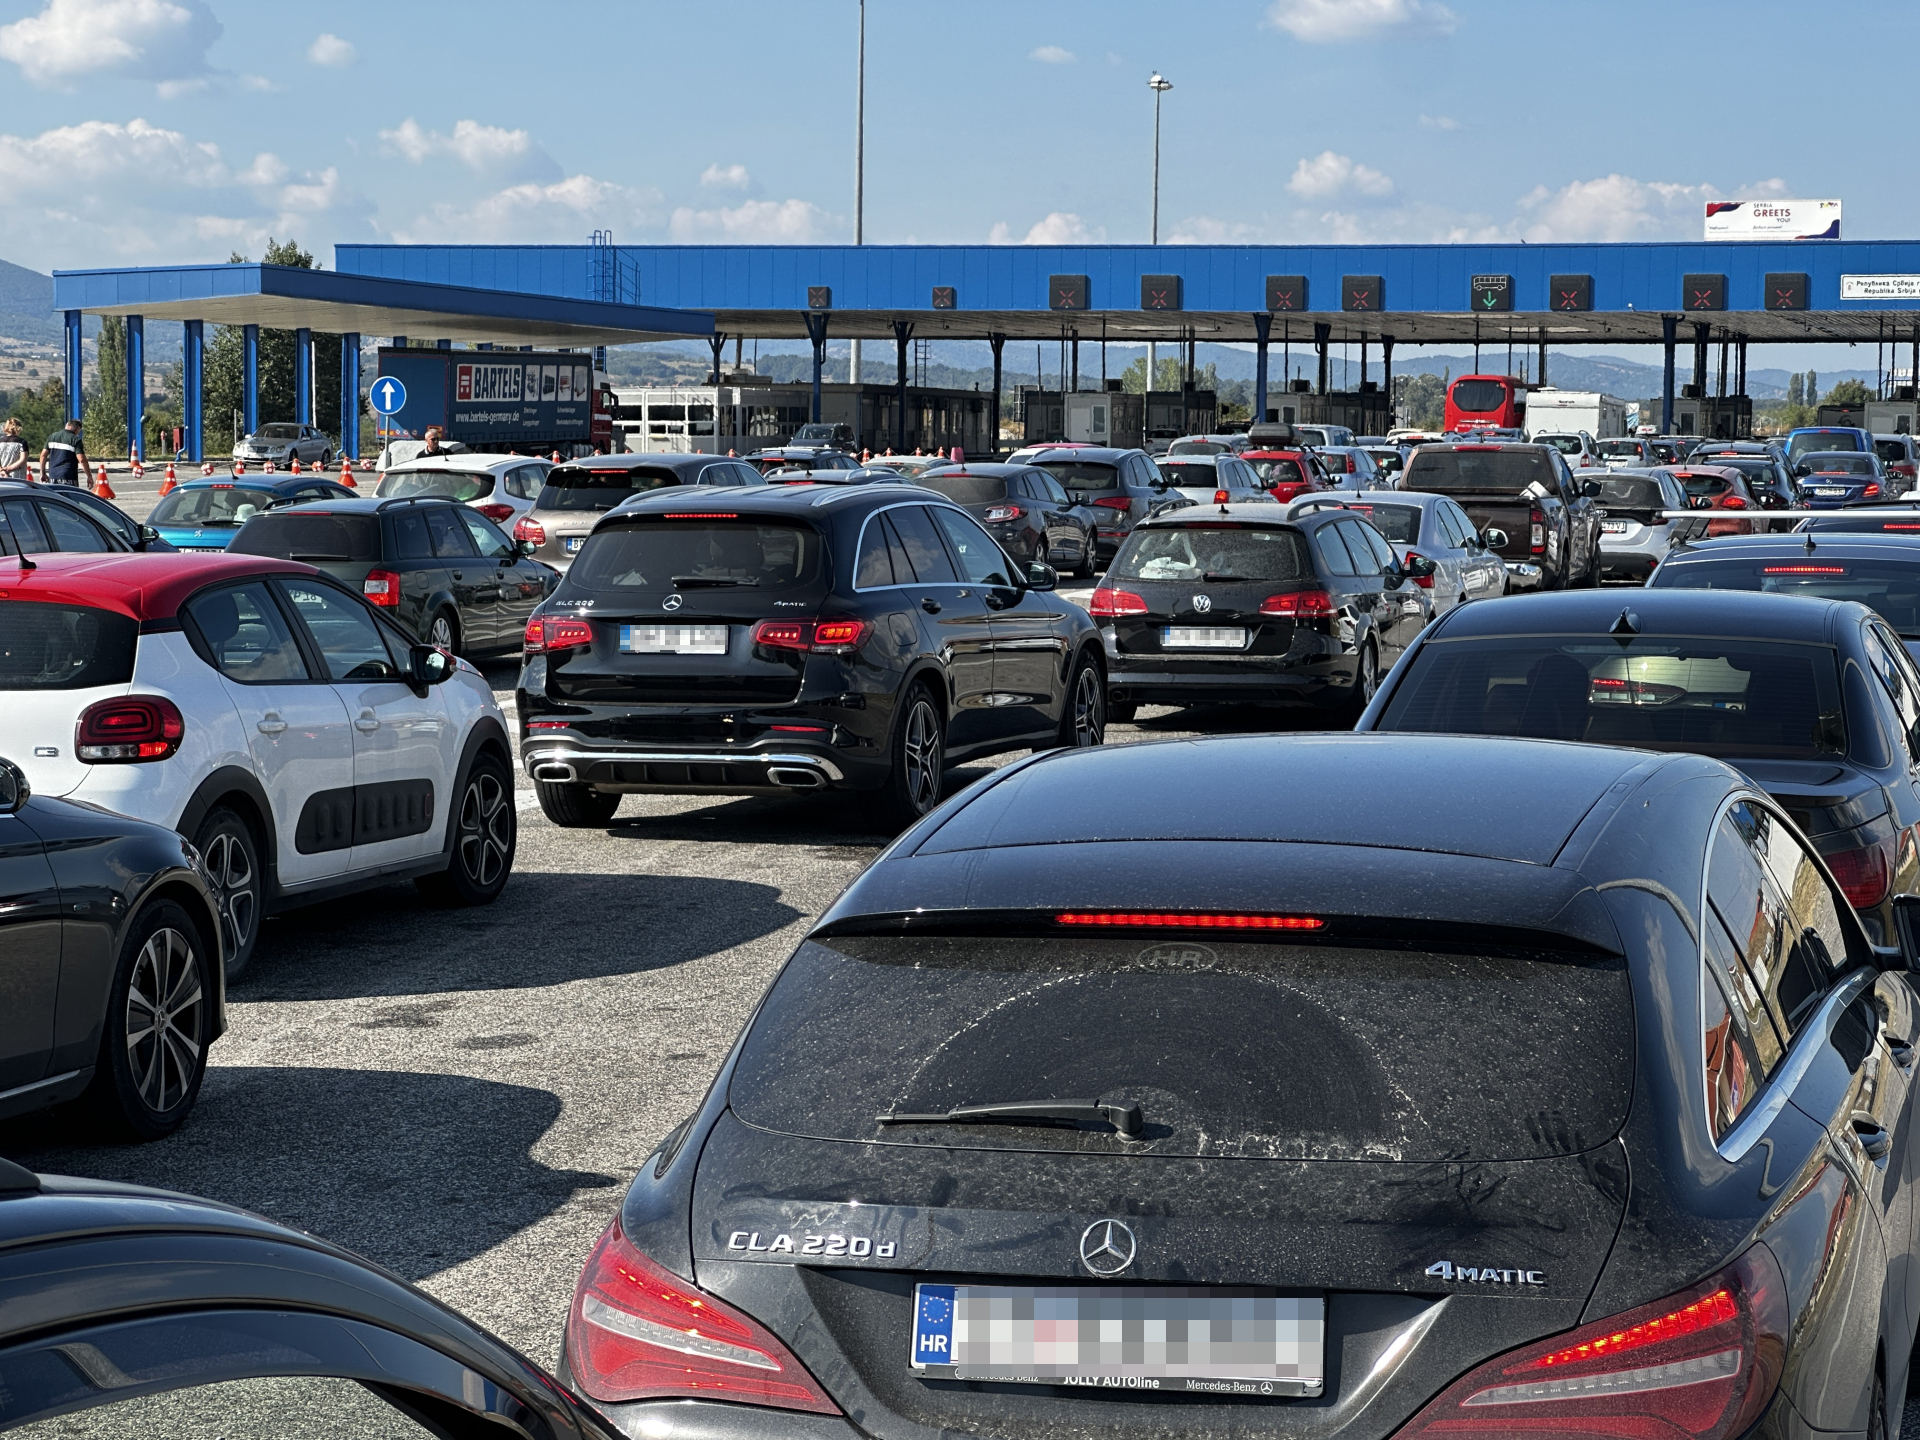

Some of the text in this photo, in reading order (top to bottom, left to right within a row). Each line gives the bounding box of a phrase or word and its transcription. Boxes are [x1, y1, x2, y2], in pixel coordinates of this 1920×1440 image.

[1753, 208, 1791, 217] GREETS
[474, 367, 521, 399] BARTELS
[455, 410, 520, 425] www.bartels-germany.de
[33, 746, 60, 758] C3
[728, 1231, 794, 1253] CLA
[1424, 1260, 1544, 1284] 4MATIC
[920, 1334, 948, 1353] HR
[1063, 1376, 1160, 1389] JOLLY AUTOline
[1186, 1379, 1257, 1393] Mercedes-Benz
